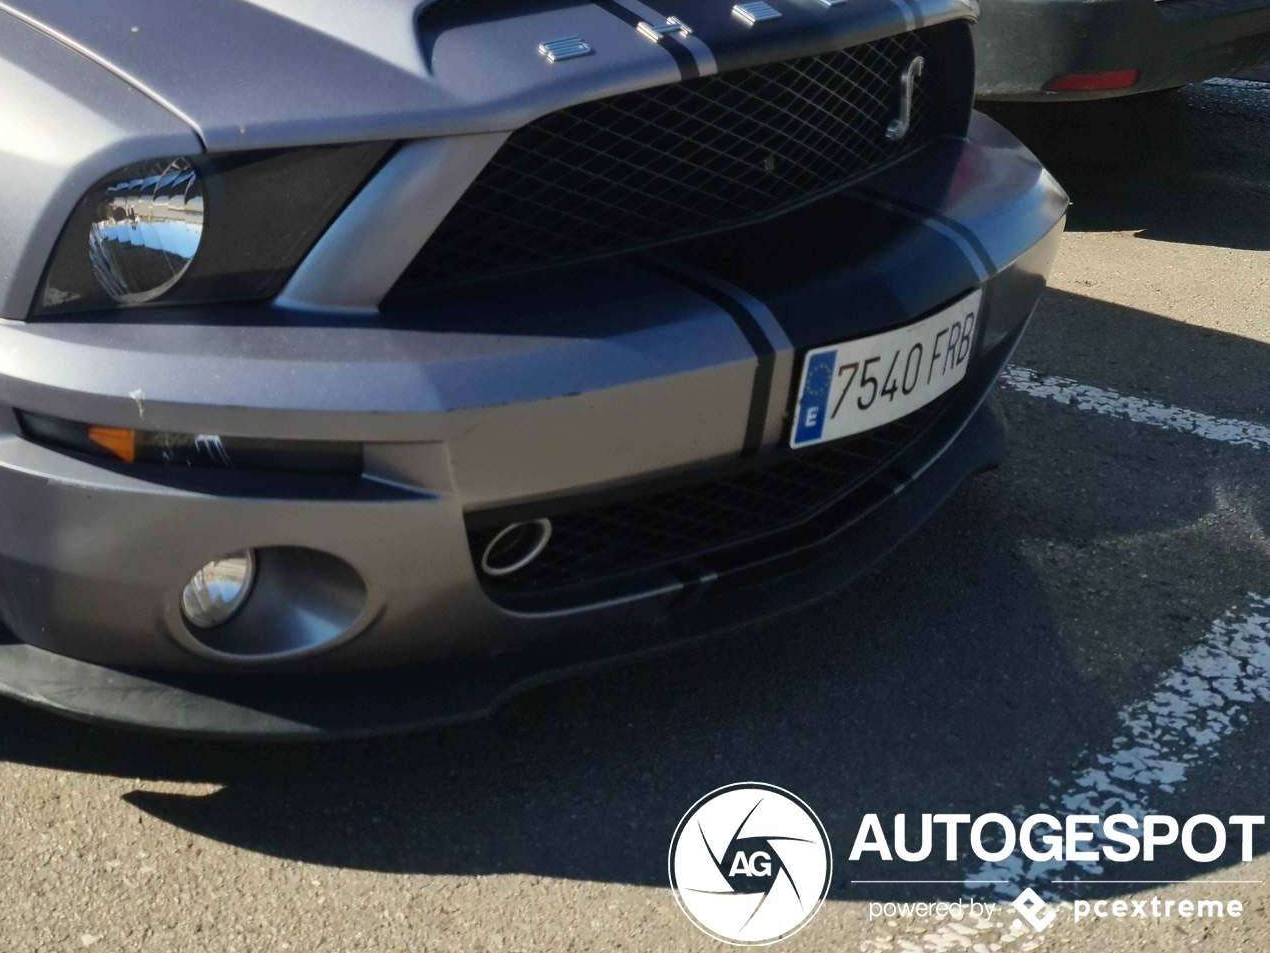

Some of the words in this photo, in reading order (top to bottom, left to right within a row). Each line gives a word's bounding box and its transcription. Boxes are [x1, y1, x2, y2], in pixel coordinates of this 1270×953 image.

[805, 406, 819, 427] E
[831, 342, 924, 420] 7540
[927, 312, 976, 386] FRB
